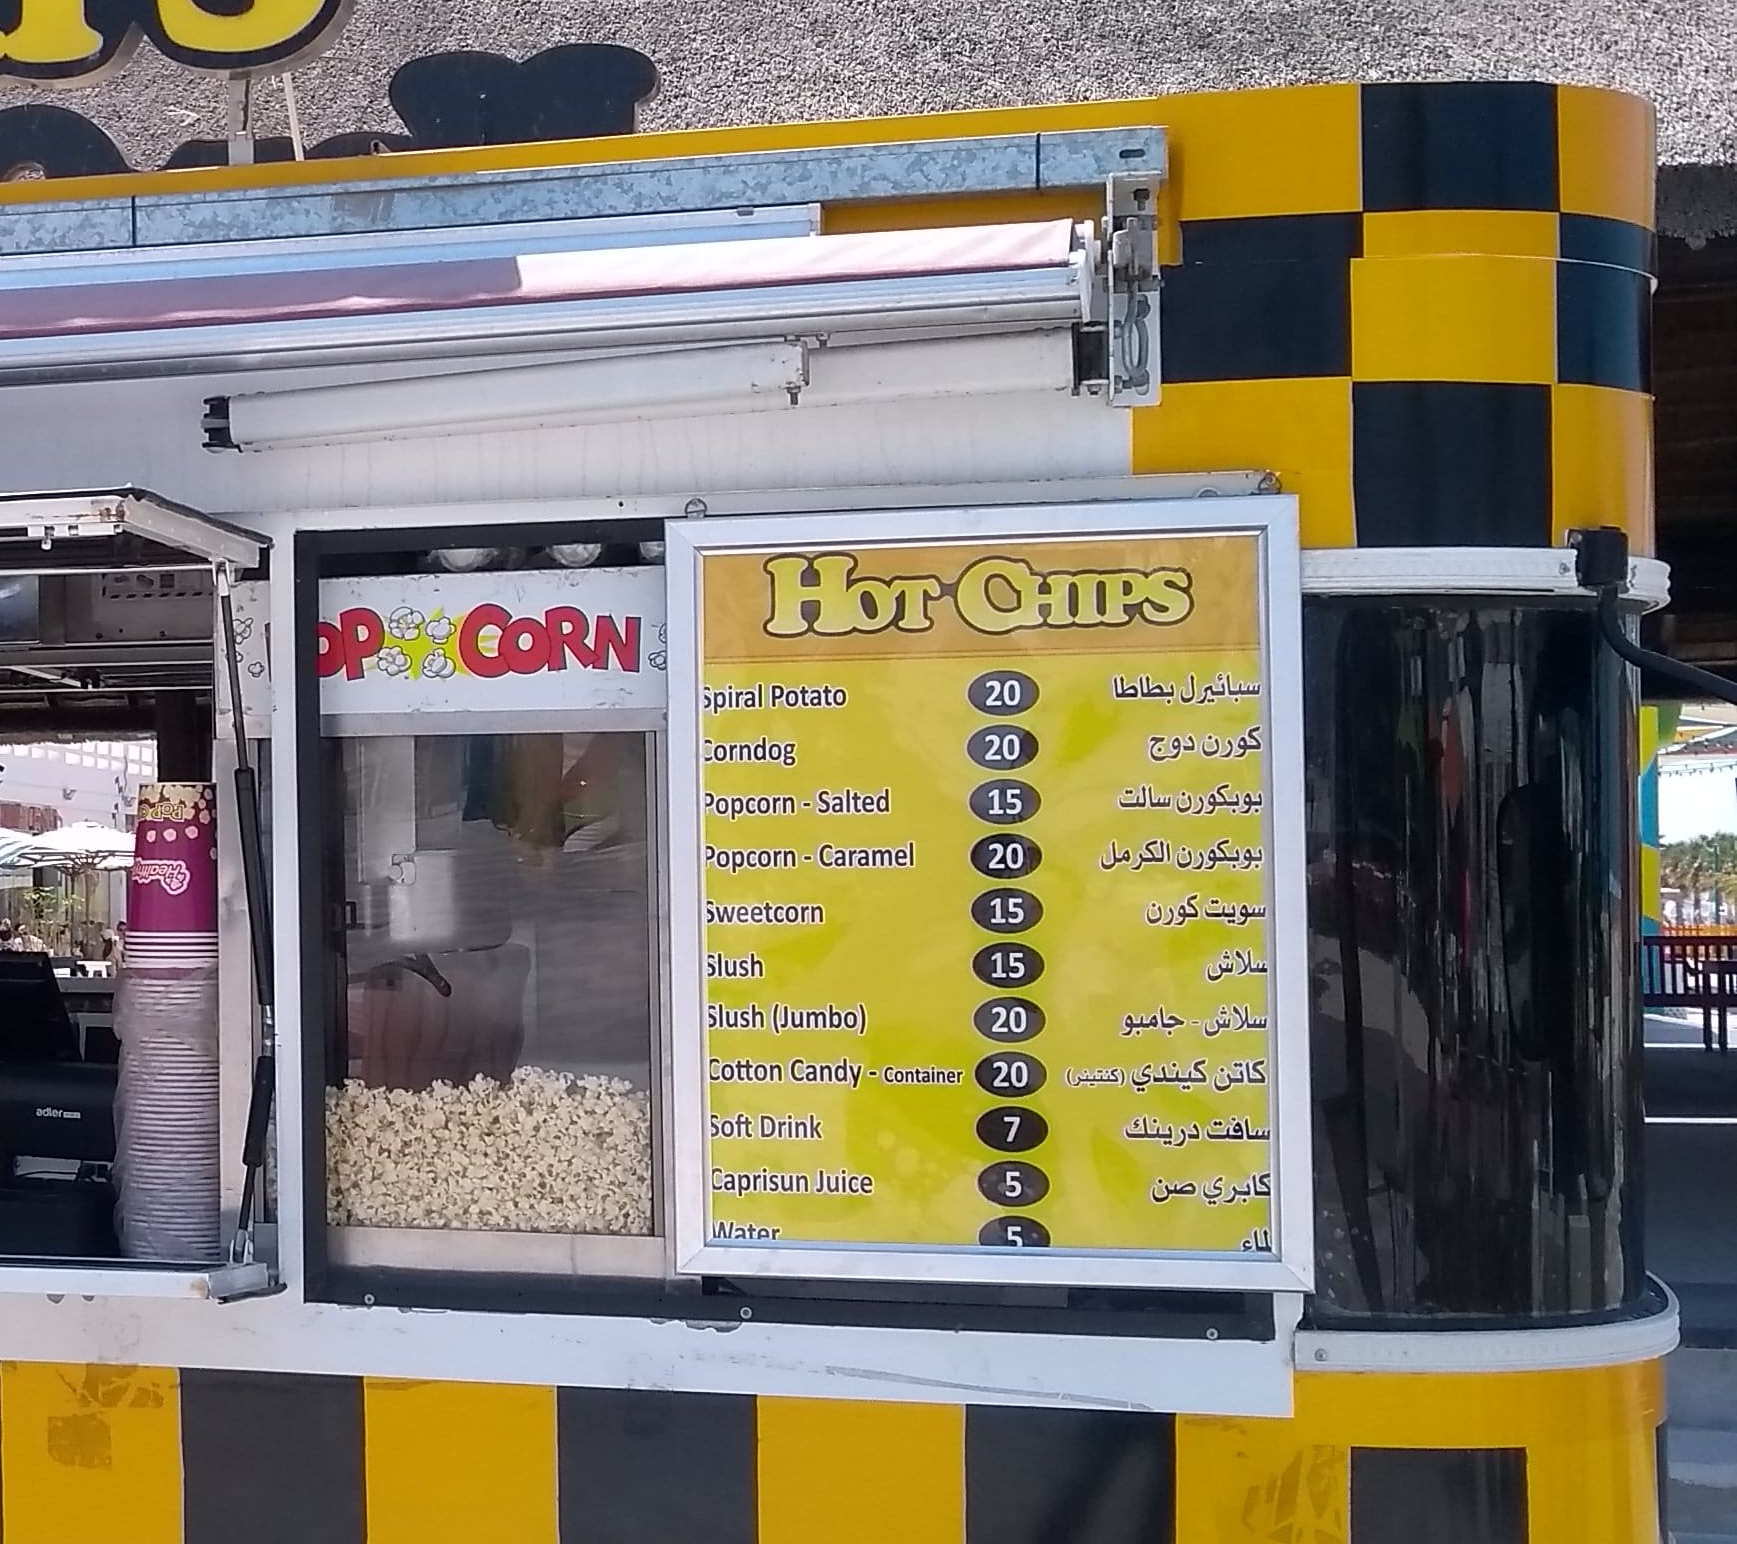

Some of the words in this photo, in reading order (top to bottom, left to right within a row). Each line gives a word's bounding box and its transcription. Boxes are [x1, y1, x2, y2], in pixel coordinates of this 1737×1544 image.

[957, 555, 1194, 635] CHIPS
[317, 607, 385, 681] OP
[459, 603, 642, 678] CORN
[771, 684, 847, 707] Potato
[984, 679, 1021, 707] 20
[1113, 675, 1175, 704] بطاطا
[984, 734, 1021, 761] 20
[1149, 734, 1196, 761] دوج
[1201, 725, 1262, 758] كورن
[817, 788, 890, 814] Salted
[987, 788, 1023, 815] 15
[1118, 785, 1171, 808] سالت
[1176, 783, 1263, 814] بوبكورن
[819, 842, 914, 867] Caramel
[988, 842, 1024, 869] 20
[1100, 839, 1171, 870] الكرمل
[1176, 839, 1263, 870] بوبكورن
[989, 897, 1025, 924] 15
[1146, 894, 1199, 926] كورن
[1205, 898, 1266, 925] سويت
[990, 952, 1026, 978] 15
[1207, 949, 1268, 981] سلاش
[773, 1003, 867, 1034] (Jumbo)
[990, 1006, 1027, 1033] 20
[1121, 1006, 1185, 1036] جامبو
[1204, 1005, 1267, 1036] سلاش
[709, 1059, 783, 1082] Cotton
[790, 1058, 862, 1088] Candy
[884, 1066, 964, 1084] Container
[992, 1060, 1029, 1088] 20
[1131, 1059, 1208, 1093] كيندي
[1214, 1059, 1266, 1091] كاتن
[760, 1114, 823, 1139] Drink
[1003, 1116, 1021, 1143] 7
[1124, 1115, 1201, 1147] درينك
[712, 1167, 809, 1196] Caprisun
[815, 1169, 874, 1194] Juice
[1005, 1171, 1023, 1198] 5
[1151, 1178, 1197, 1203] صن
[1006, 1225, 1024, 1248] 5
